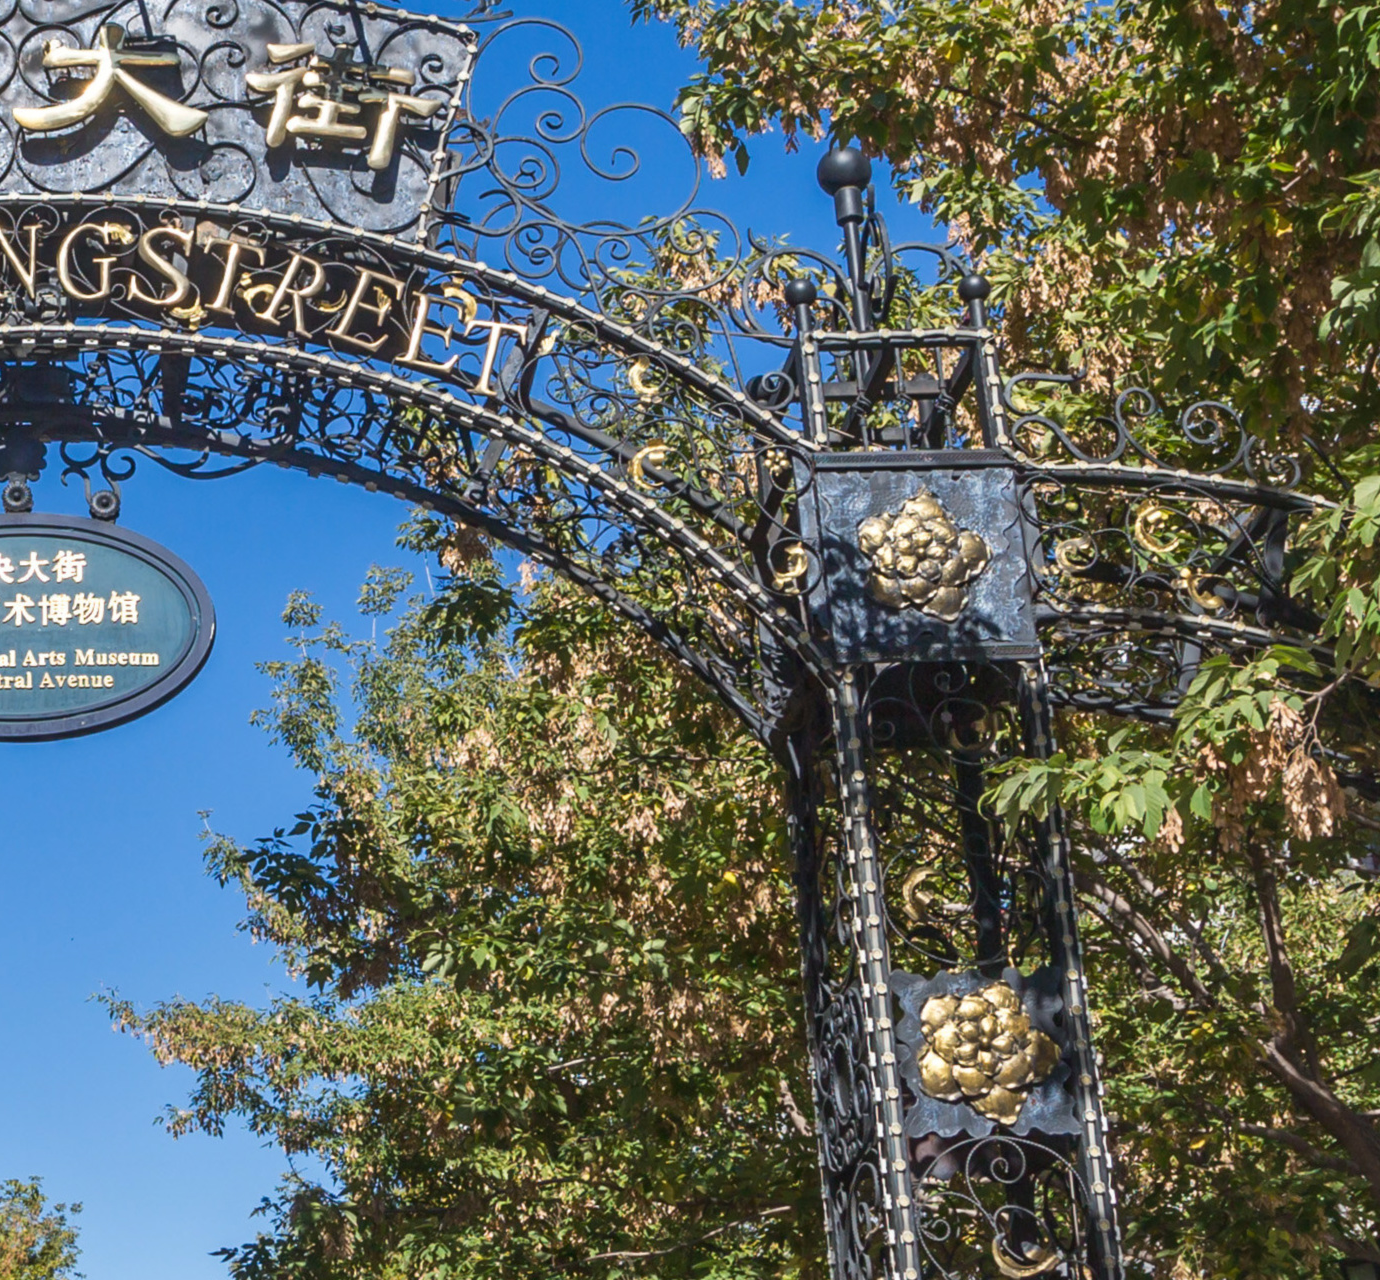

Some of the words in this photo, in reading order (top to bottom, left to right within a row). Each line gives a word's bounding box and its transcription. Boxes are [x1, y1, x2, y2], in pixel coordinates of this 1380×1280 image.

[22, 649, 66, 668] Arts
[73, 648, 160, 667] Museum
[39, 670, 114, 690] Avenue
